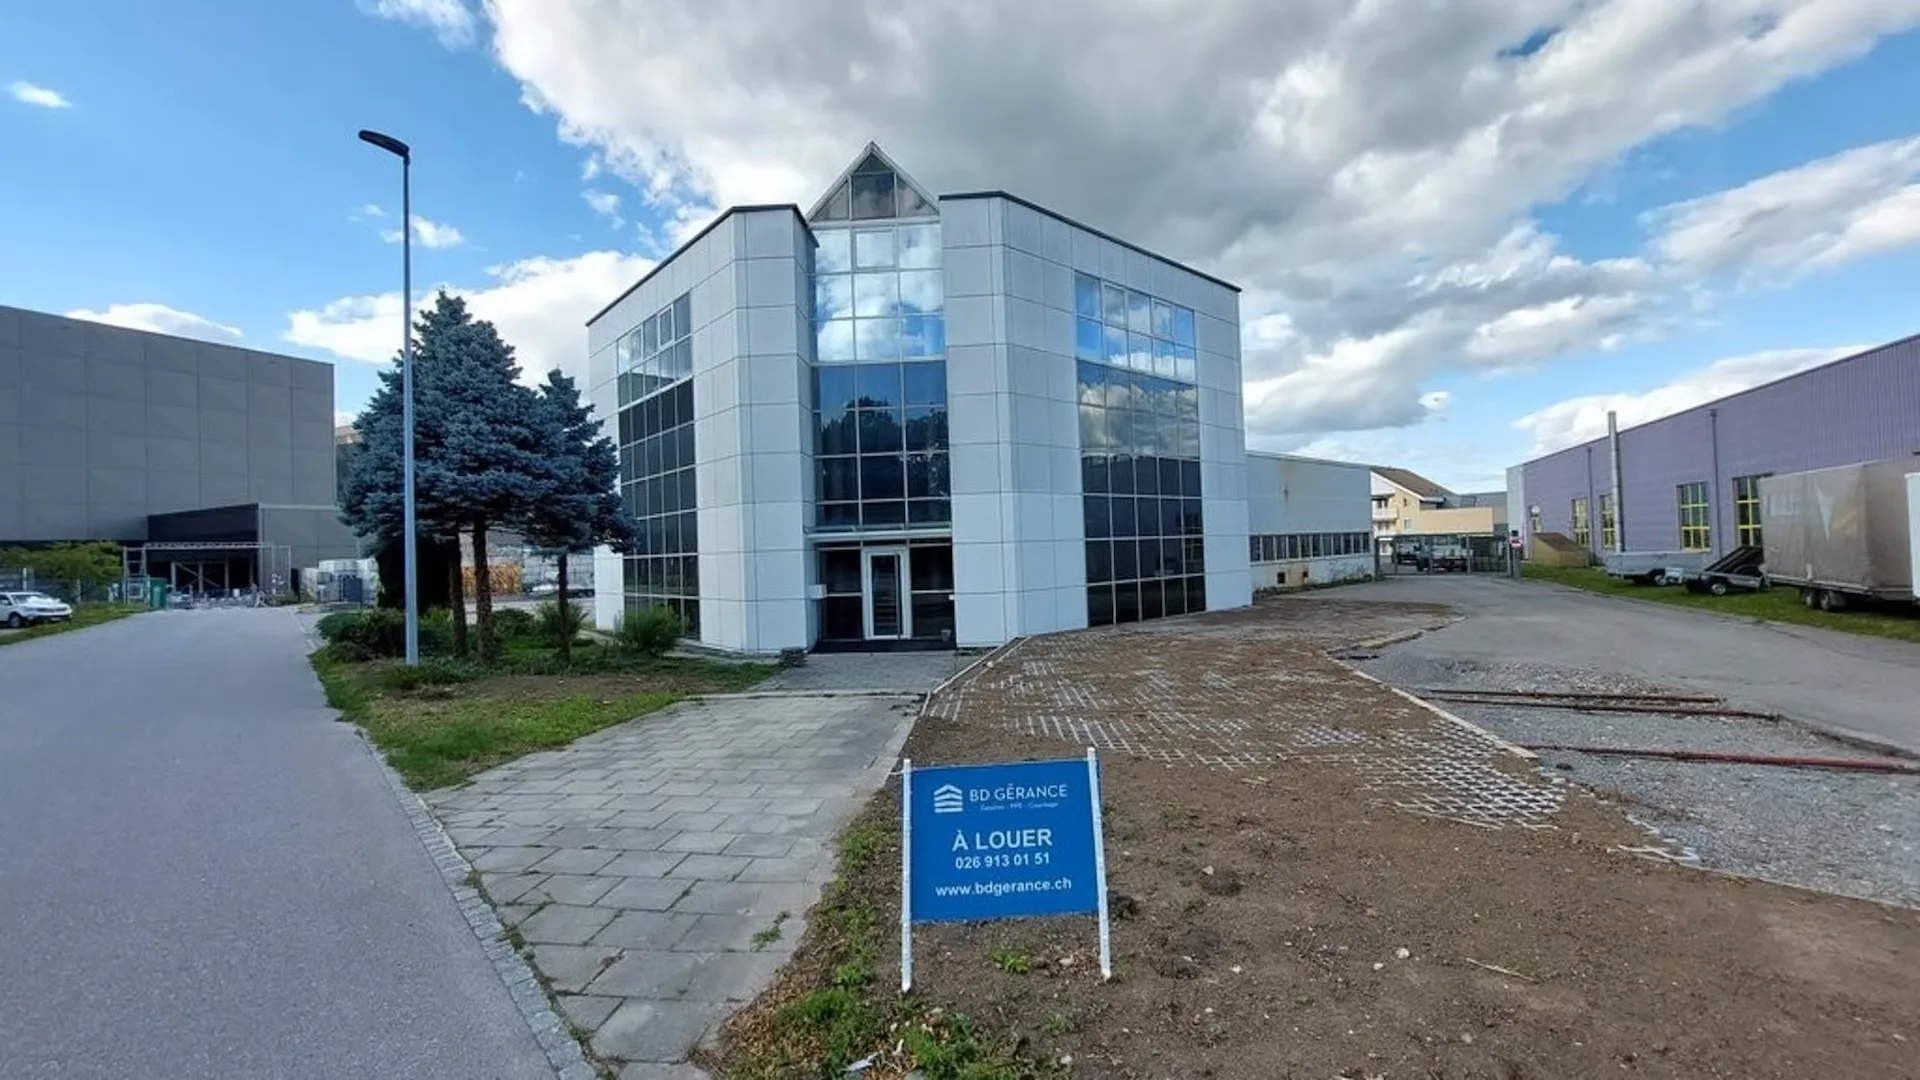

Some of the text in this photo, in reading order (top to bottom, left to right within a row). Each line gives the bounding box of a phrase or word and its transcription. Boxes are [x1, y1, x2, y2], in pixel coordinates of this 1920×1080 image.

[970, 783, 1068, 802] BD GÉRANCE
[952, 828, 1053, 852] À LOUER
[955, 852, 1050, 869] 026 913 01 51
[935, 877, 1072, 896] www.bdgerance.ch
